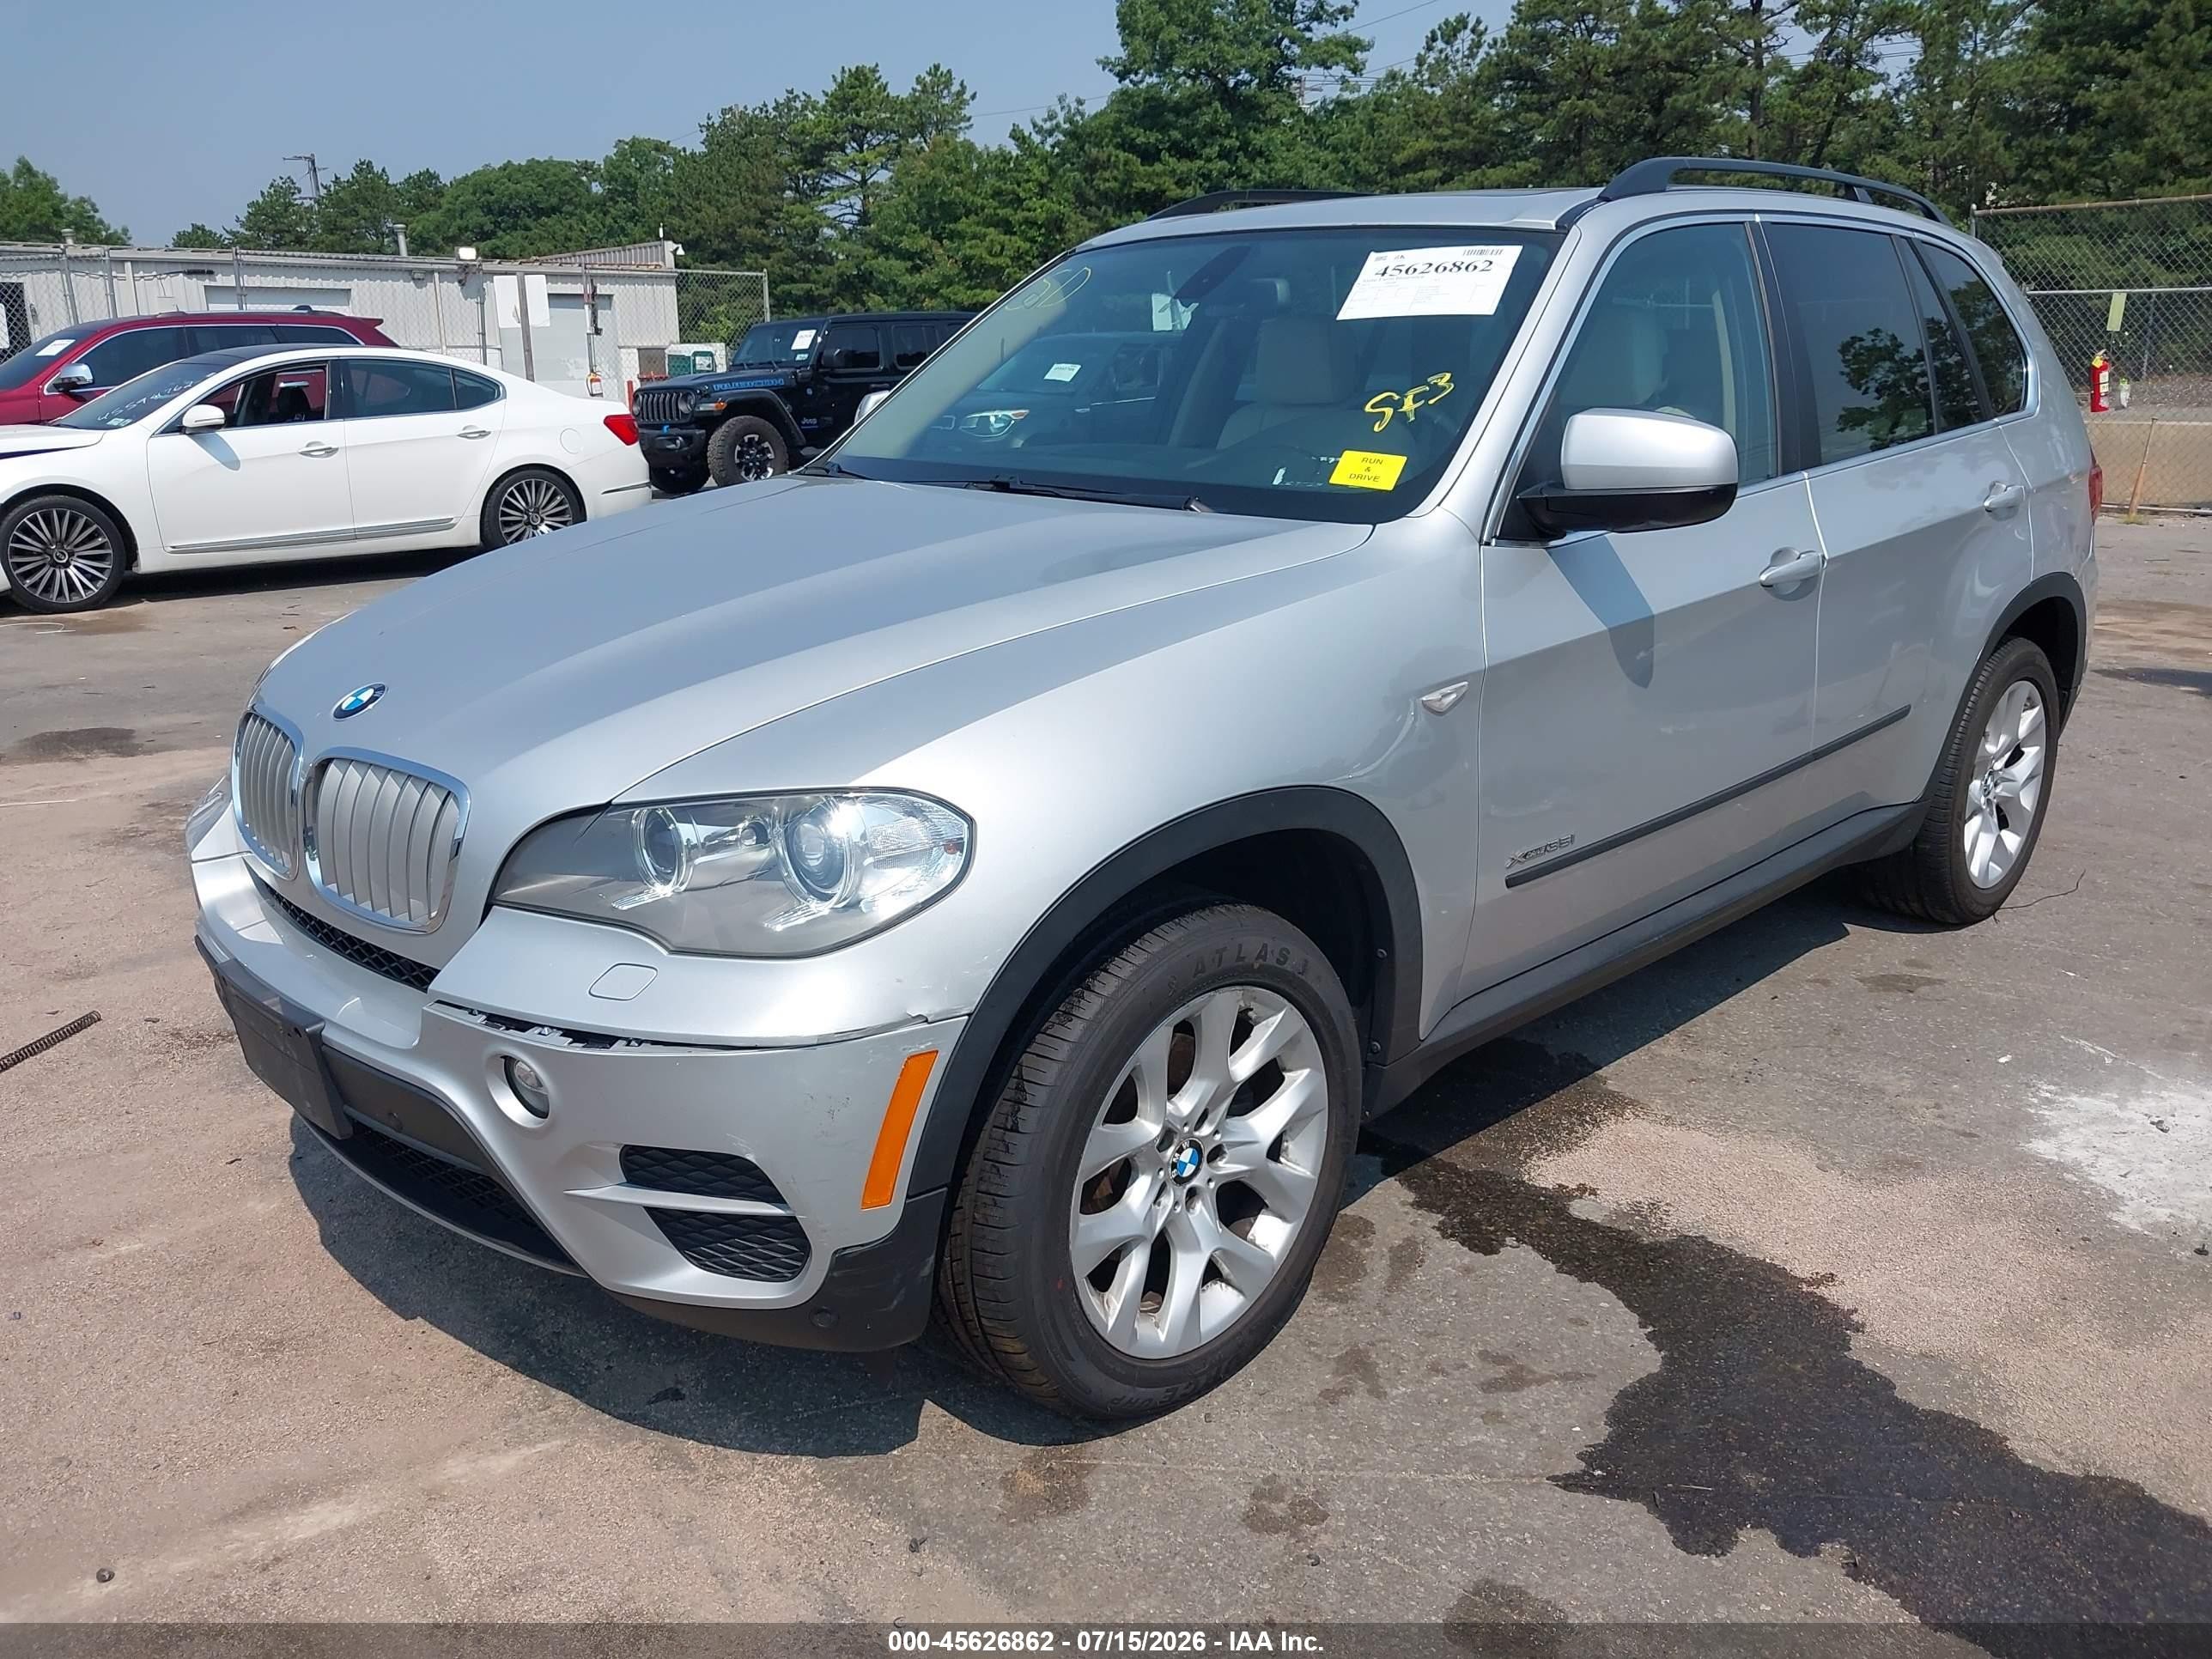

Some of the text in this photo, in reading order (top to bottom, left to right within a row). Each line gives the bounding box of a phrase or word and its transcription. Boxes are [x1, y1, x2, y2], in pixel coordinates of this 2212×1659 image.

[1374, 258, 1494, 277] 45626862
[1361, 457, 1384, 465] RUN
[1348, 472, 1381, 483] DRIVE
[1193, 942, 1291, 978] ATLAS
